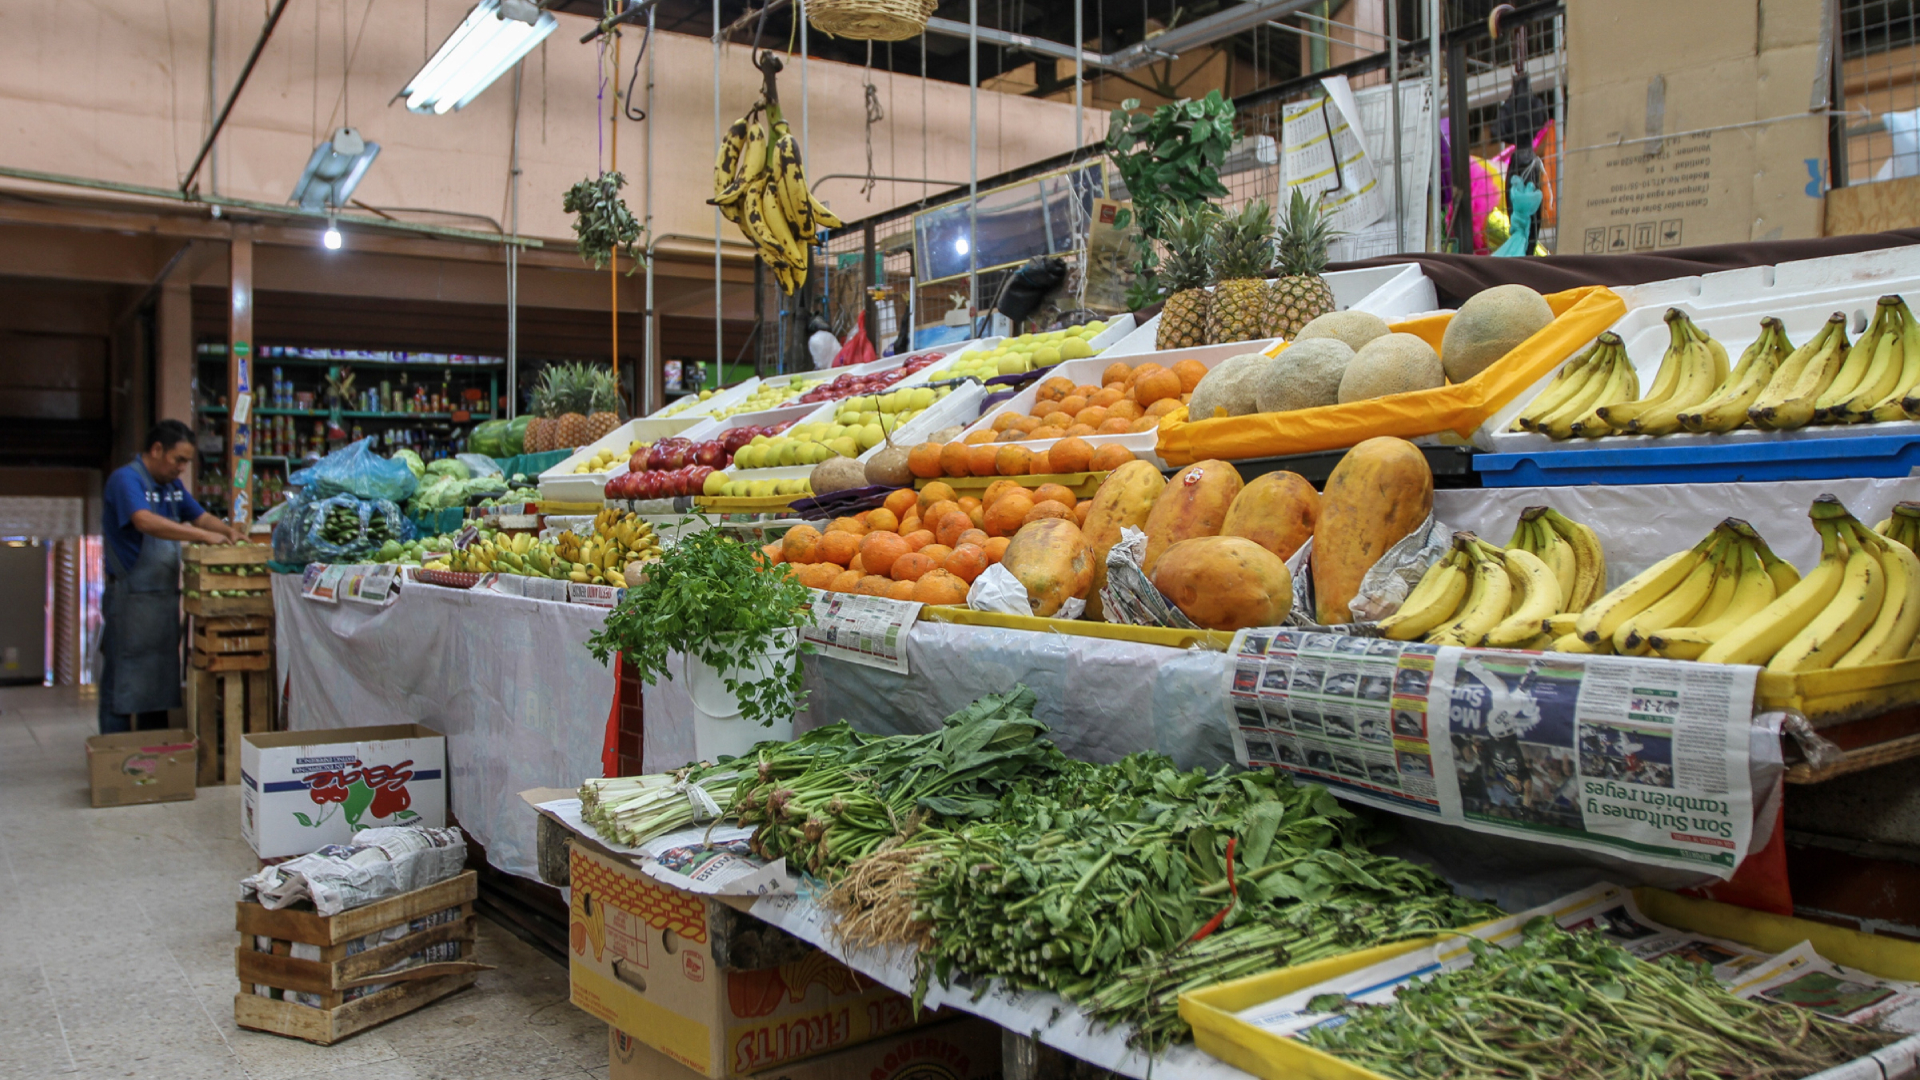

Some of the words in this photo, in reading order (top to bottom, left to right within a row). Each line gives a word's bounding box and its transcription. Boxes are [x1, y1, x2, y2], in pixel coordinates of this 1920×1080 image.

[1675, 144, 1711, 156] Volumen:
[1673, 157, 1711, 170] Cantidad:
[1681, 171, 1710, 183] Modelo
[1646, 188, 1665, 199] agua
[1667, 188, 1677, 197] de
[1678, 183, 1710, 196] (Tanque
[1587, 196, 1617, 208] presión)
[1619, 194, 1634, 204] baja
[1636, 193, 1645, 203] de
[1610, 206, 1630, 217] Agua
[1632, 206, 1641, 216] de
[1642, 203, 1663, 214] Solar
[334, 762, 344, 770] AN
[1584, 780, 1637, 803] reyes
[1586, 797, 1601, 816] y
[1640, 790, 1730, 818] también
[1602, 801, 1690, 833] Sultanes
[1690, 816, 1733, 838] Son
[1680, 849, 1712, 862] DEPORTES
[735, 1007, 849, 1073] FRUITS
